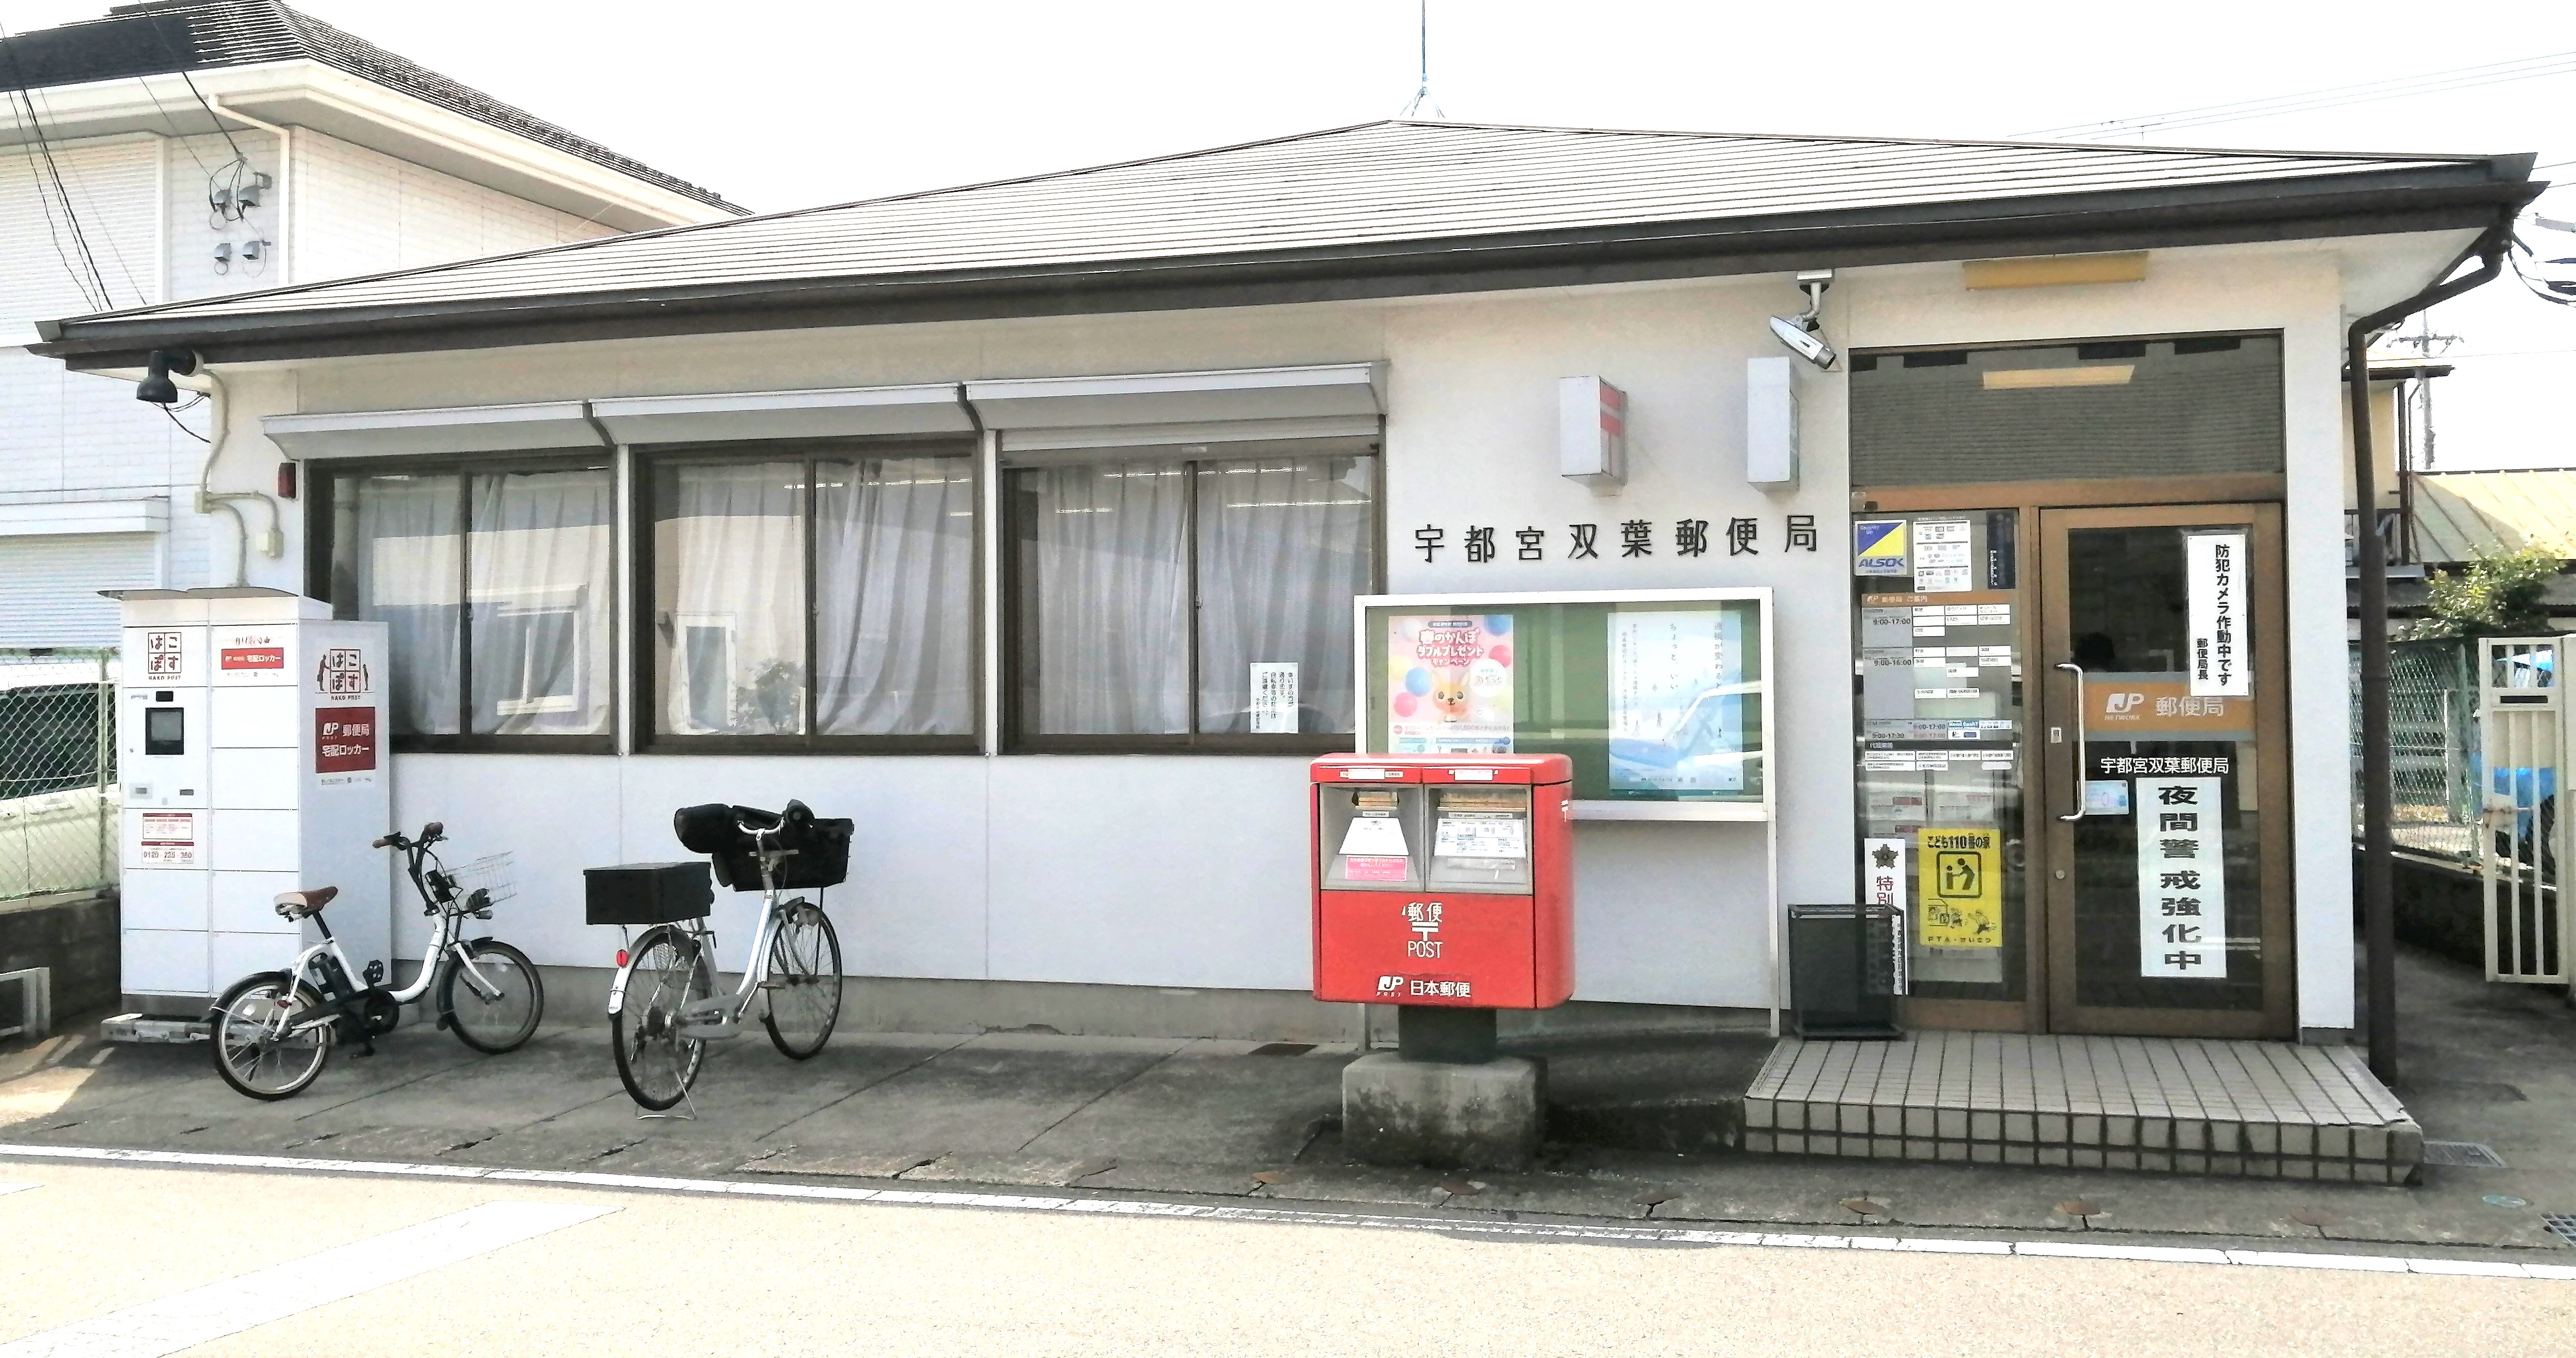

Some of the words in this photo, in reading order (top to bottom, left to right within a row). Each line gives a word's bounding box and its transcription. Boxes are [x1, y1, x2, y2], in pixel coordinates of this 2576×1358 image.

[1415, 515, 1818, 564] 宇都宮双葉郵便局
[1858, 558, 1904, 567] ALSOK
[2215, 544, 2232, 686] 防犯カメラ作動中です
[1874, 659, 1912, 667] 9:00-16:00
[2106, 693, 2144, 713] JP
[2156, 696, 2224, 717] 郵便局
[342, 723, 370, 736] 郵便局
[322, 744, 369, 757] 宅配ロッカー
[2100, 757, 2229, 774] 宇都宮双葉郵便局
[2158, 786, 2202, 970] 夜間警戒強化中
[1408, 902, 1443, 922] 郵便
[1407, 940, 1443, 958] POST
[1377, 976, 1404, 991] JP
[1410, 980, 1471, 998] 日本郵便
